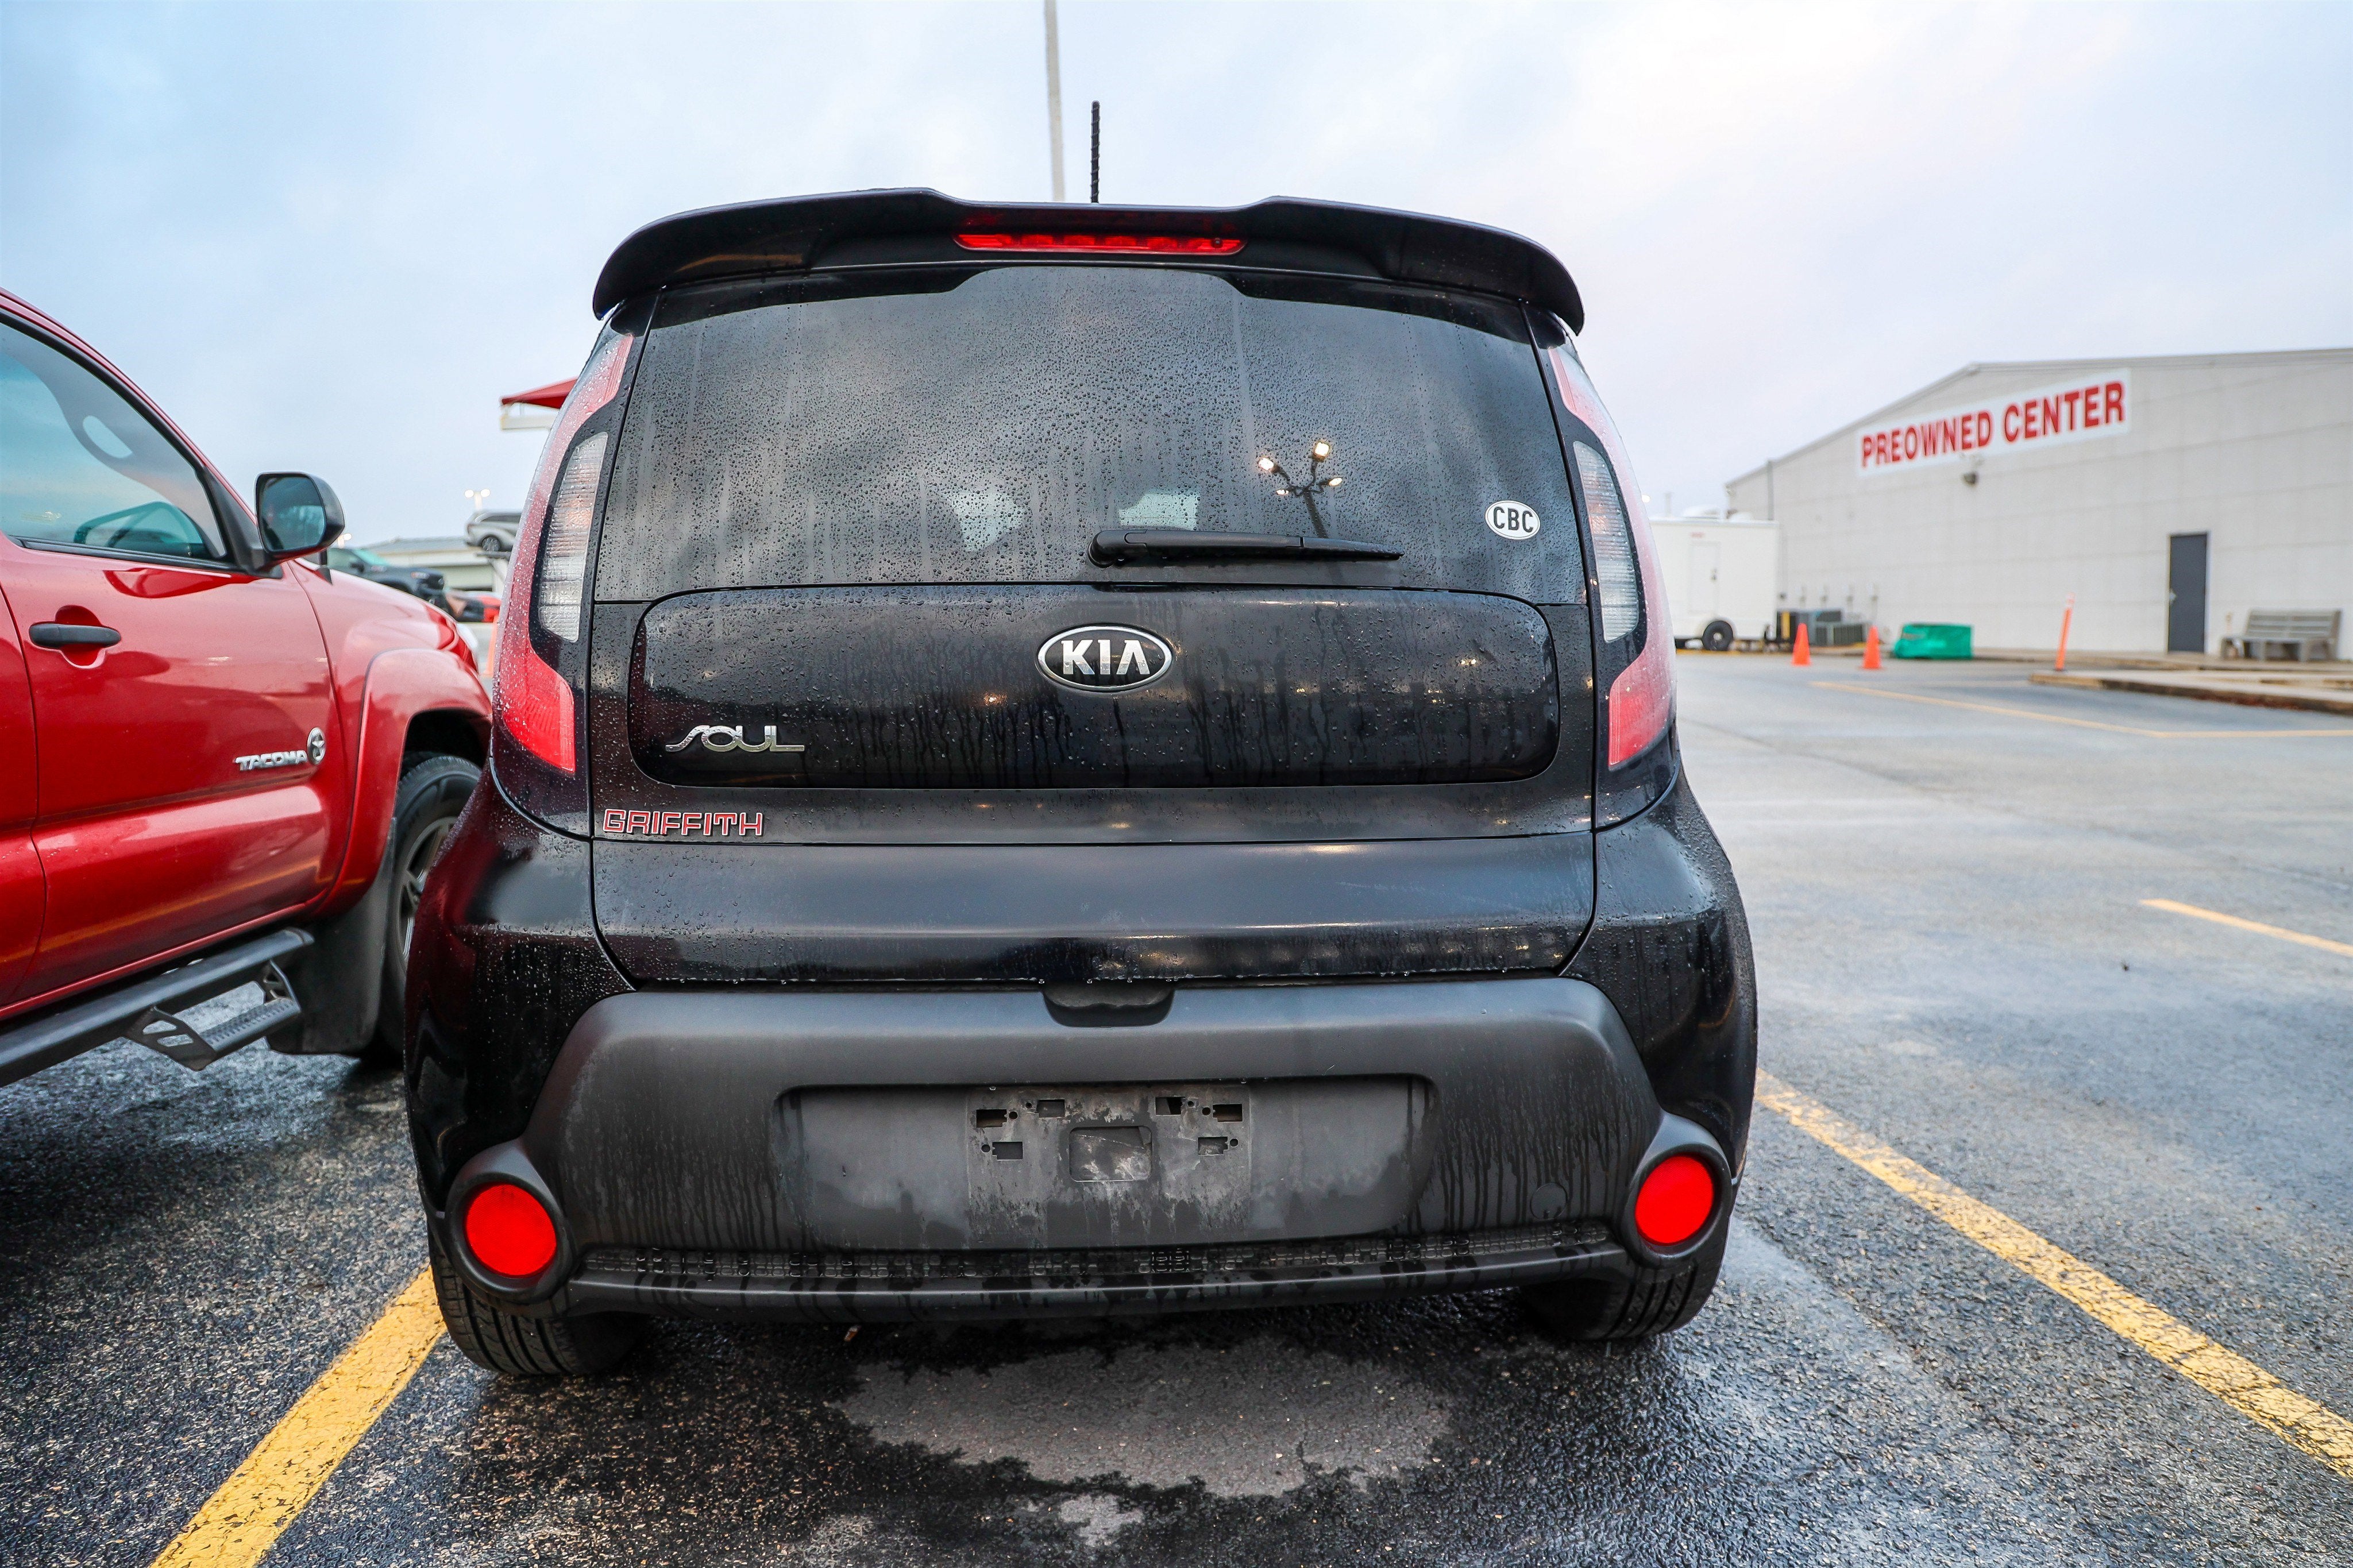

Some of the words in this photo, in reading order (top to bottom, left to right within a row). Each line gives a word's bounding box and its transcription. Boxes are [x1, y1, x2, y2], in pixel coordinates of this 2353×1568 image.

[1862, 411, 1992, 468] PREOWNED
[2003, 381, 2125, 443] CENTER
[1493, 506, 1534, 533] CBC
[1061, 639, 1150, 675] KIA
[665, 725, 805, 752] SOUL
[234, 750, 309, 771] TACOMA
[603, 808, 763, 836] GRIFFITH
